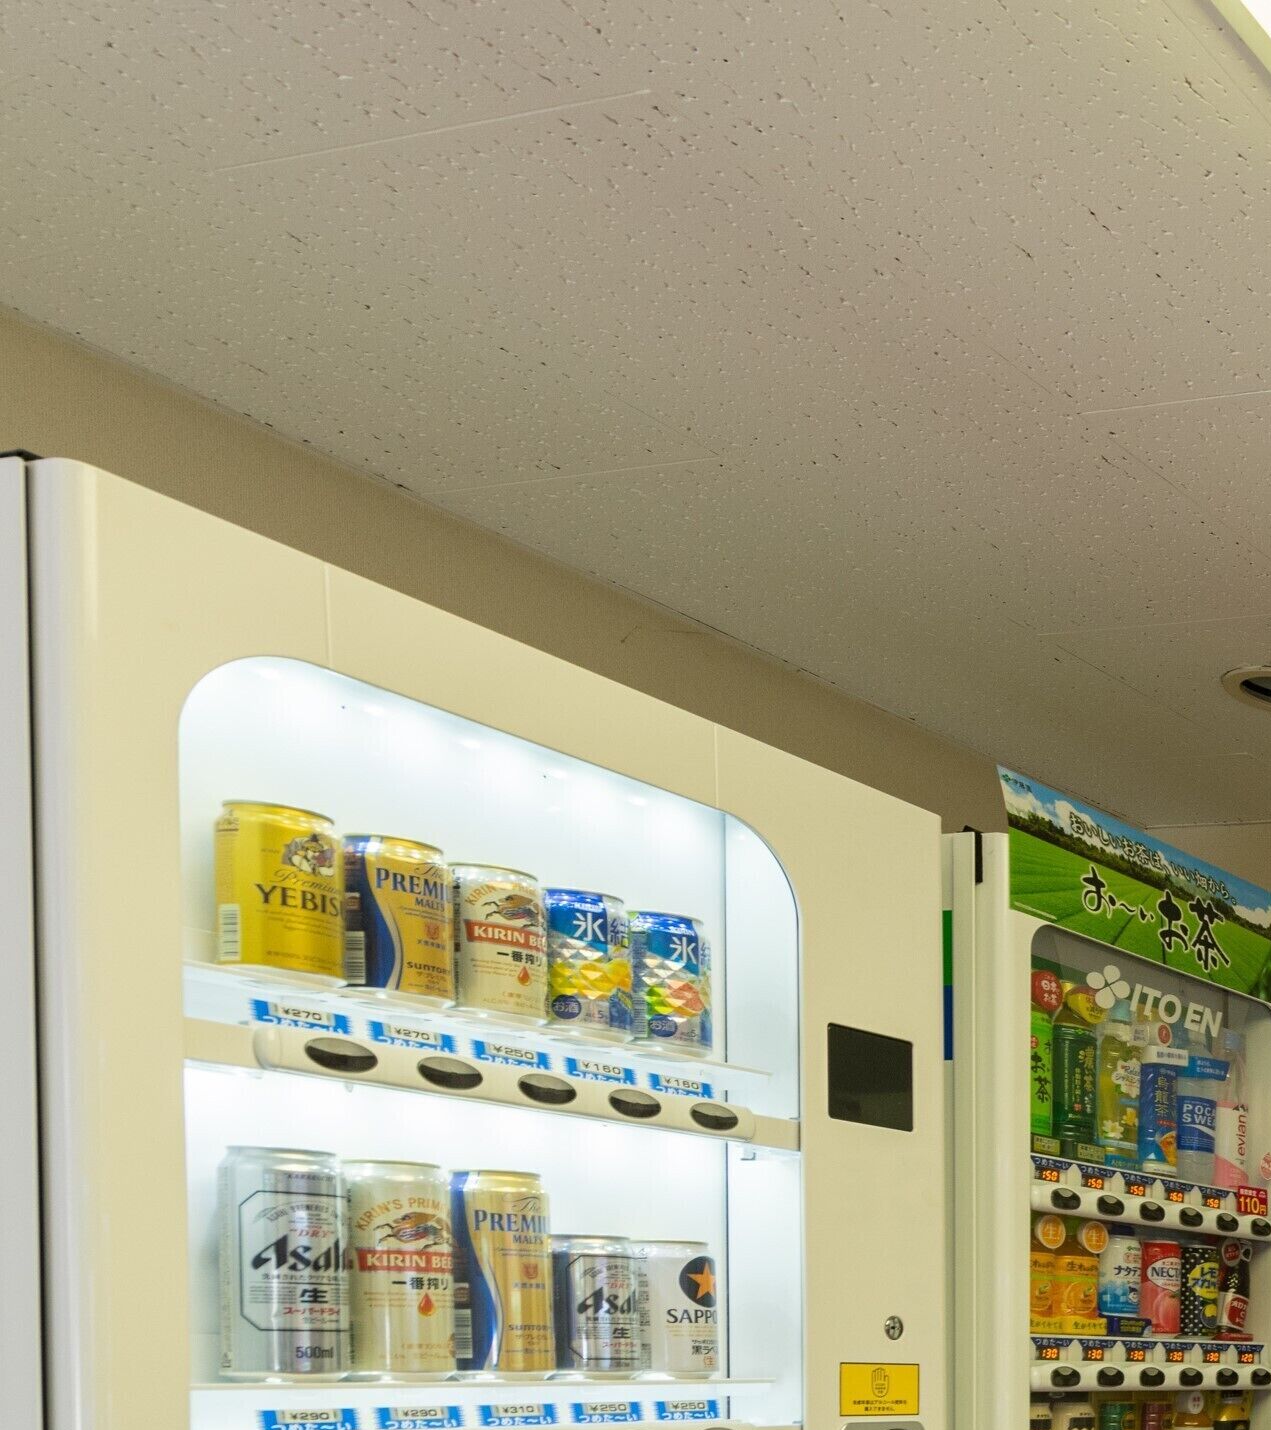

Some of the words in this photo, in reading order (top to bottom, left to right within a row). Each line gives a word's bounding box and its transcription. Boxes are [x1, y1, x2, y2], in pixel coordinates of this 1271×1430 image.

[255, 882, 343, 917] YEBIS
[473, 923, 526, 945] KIRIN
[281, 1005, 323, 1022] ¥270
[1129, 983, 1183, 1025] ITO
[1184, 1002, 1223, 1038] EN
[393, 1026, 432, 1042] ¥270
[491, 1045, 535, 1061] ¥250
[1235, 1113, 1247, 1158] evian
[1238, 1196, 1268, 1217] 110円
[366, 1252, 426, 1269] KIRIN
[391, 1276, 450, 1292] 一番搾り
[299, 1287, 329, 1304] 生
[612, 1327, 632, 1341] 生
[295, 1346, 334, 1360] 500ml
[403, 1407, 439, 1419] ¥290
[502, 1404, 536, 1415] ¥310
[588, 1402, 627, 1414] ¥250
[672, 1400, 707, 1411] ¥250
[289, 1410, 330, 1422] ¥290
